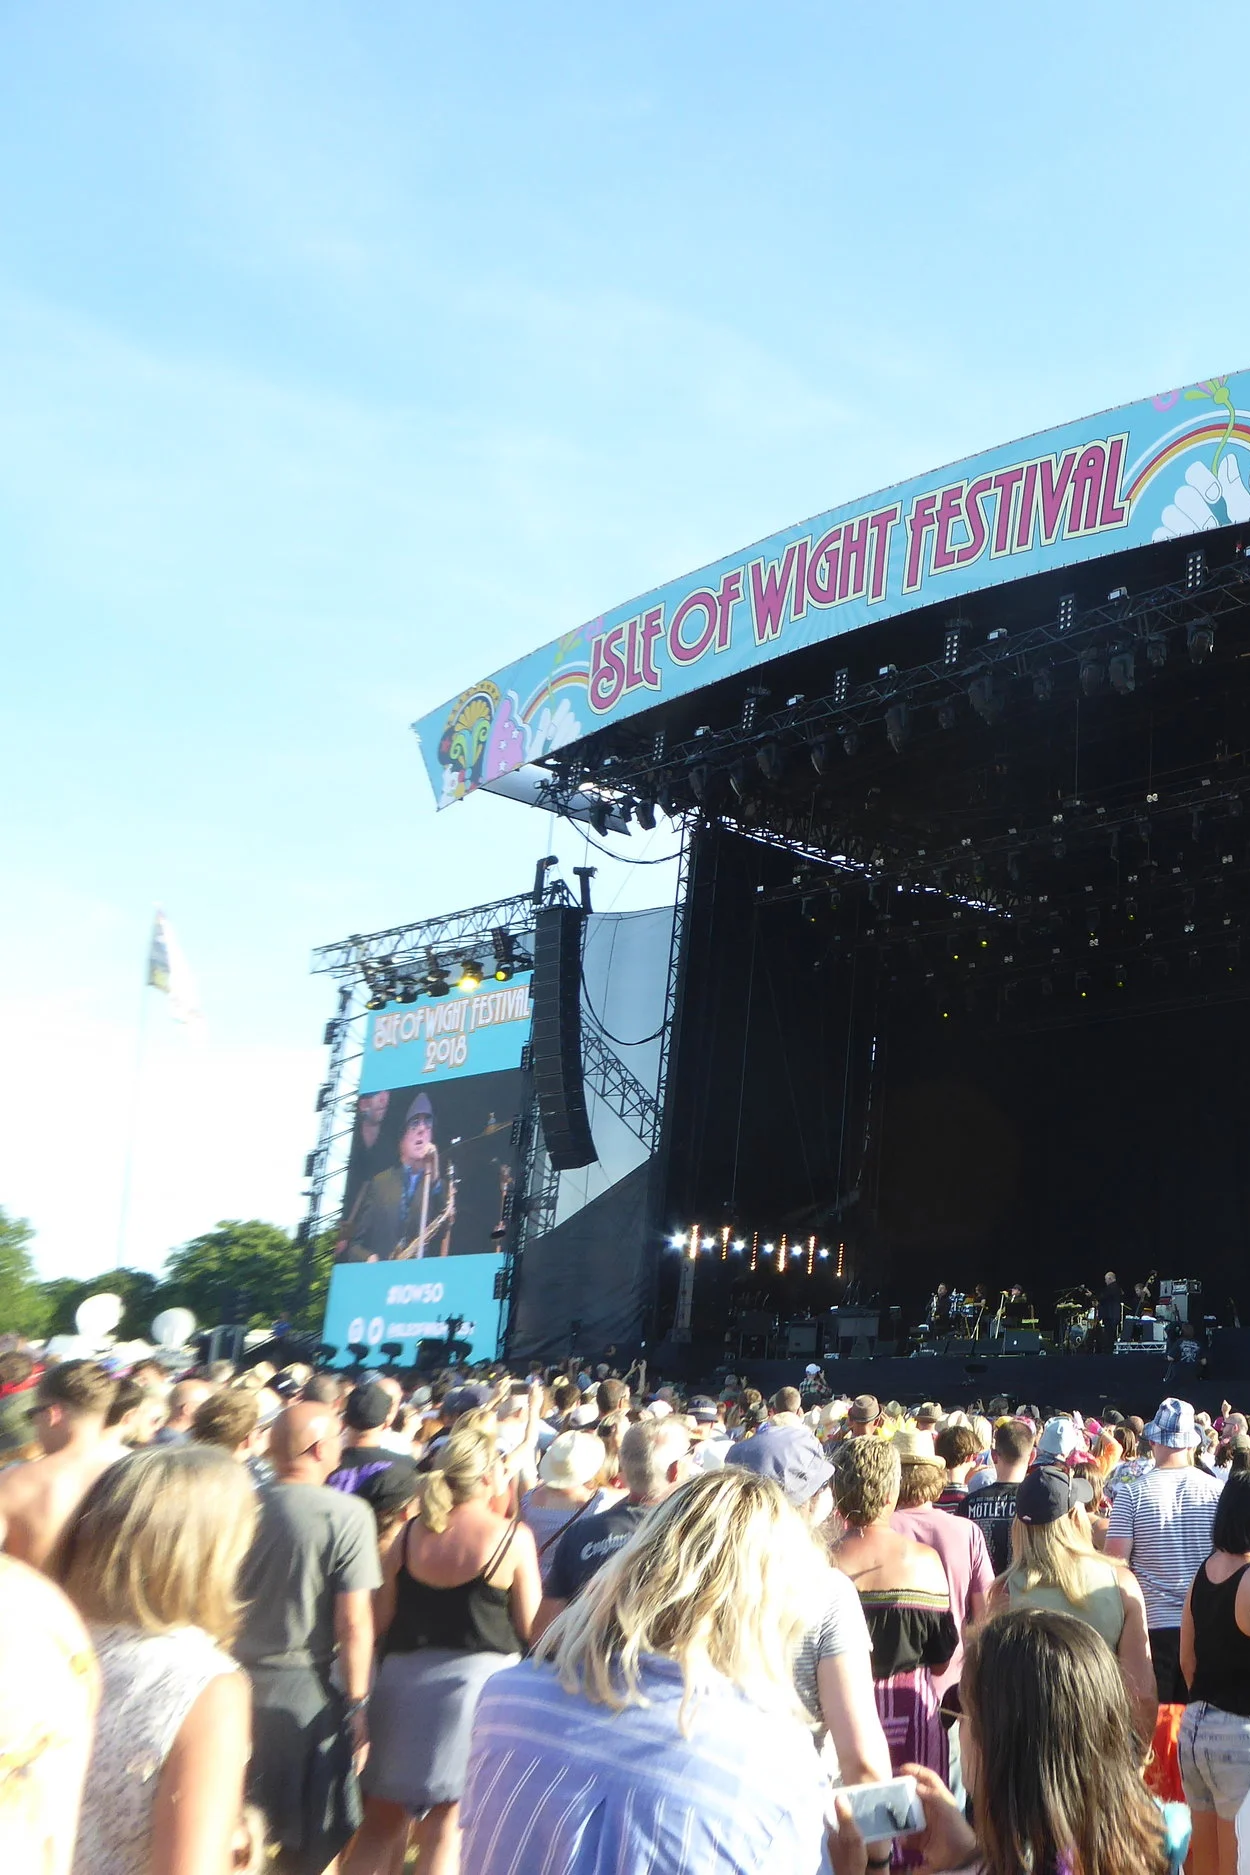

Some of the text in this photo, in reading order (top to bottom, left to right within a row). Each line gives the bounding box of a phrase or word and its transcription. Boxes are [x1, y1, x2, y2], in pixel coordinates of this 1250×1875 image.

[588, 431, 1132, 715] ISLE OF WIGHT FESTIVAL
[401, 1007, 425, 1042] OF
[424, 998, 469, 1040] WIGHT
[470, 985, 531, 1032] FESTIVAL
[422, 1034, 468, 1073] 2018
[968, 1501, 1008, 1518] MÖTLEY
